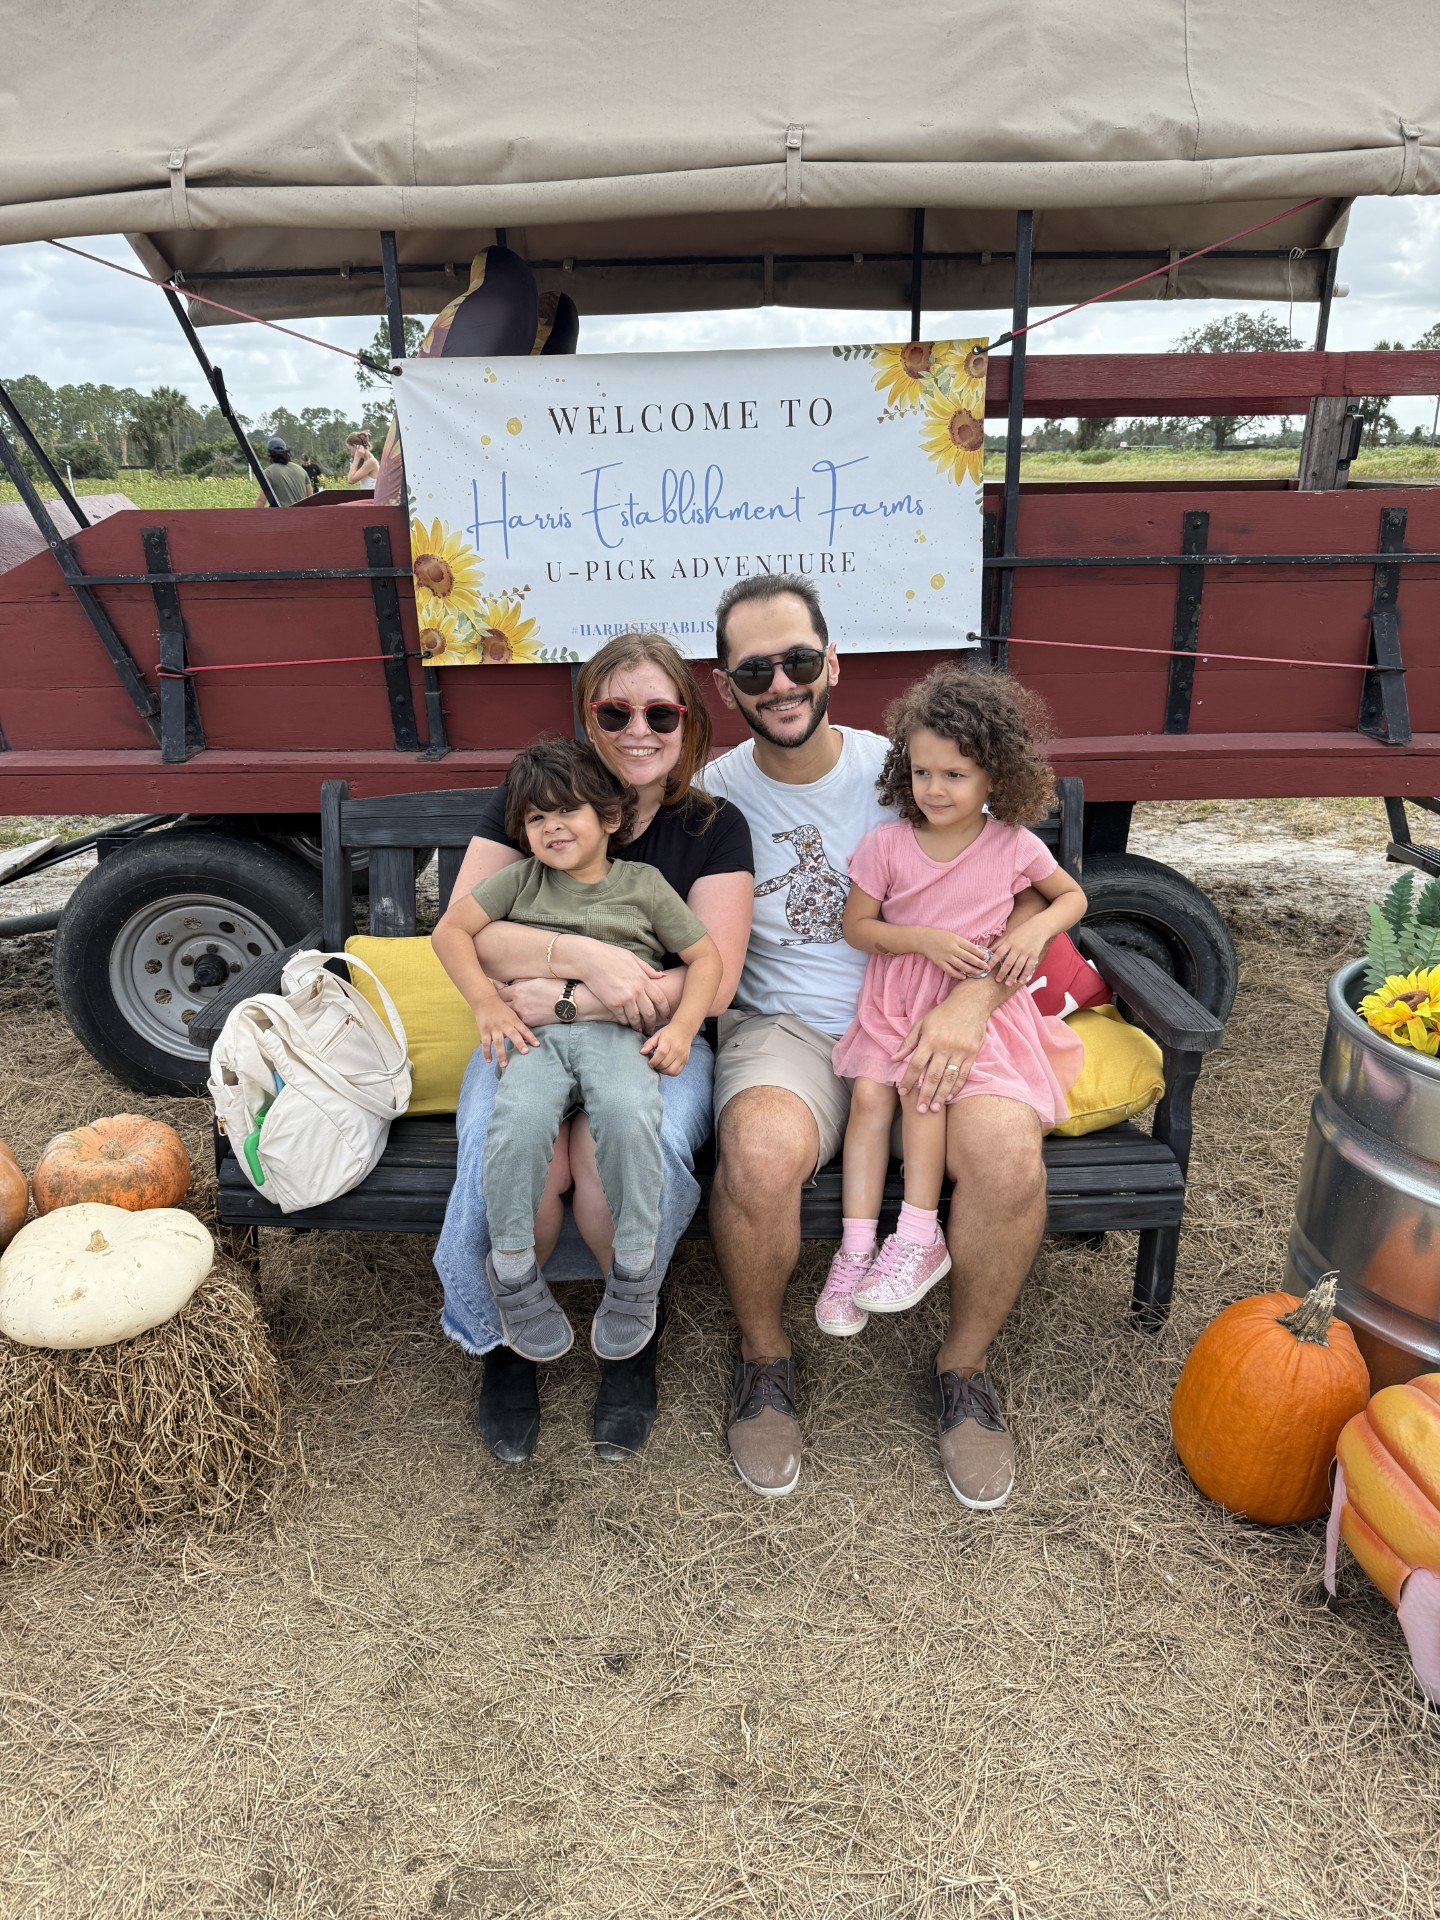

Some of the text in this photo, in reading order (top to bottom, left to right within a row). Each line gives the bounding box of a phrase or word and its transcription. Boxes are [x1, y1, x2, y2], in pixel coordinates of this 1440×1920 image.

[547, 397, 833, 435] WELCOME TO
[466, 455, 924, 560] Harris Establishment Farms
[546, 551, 856, 583] U-PICK ADVENTURE
[570, 620, 715, 637] #HARRISESTABLIS
